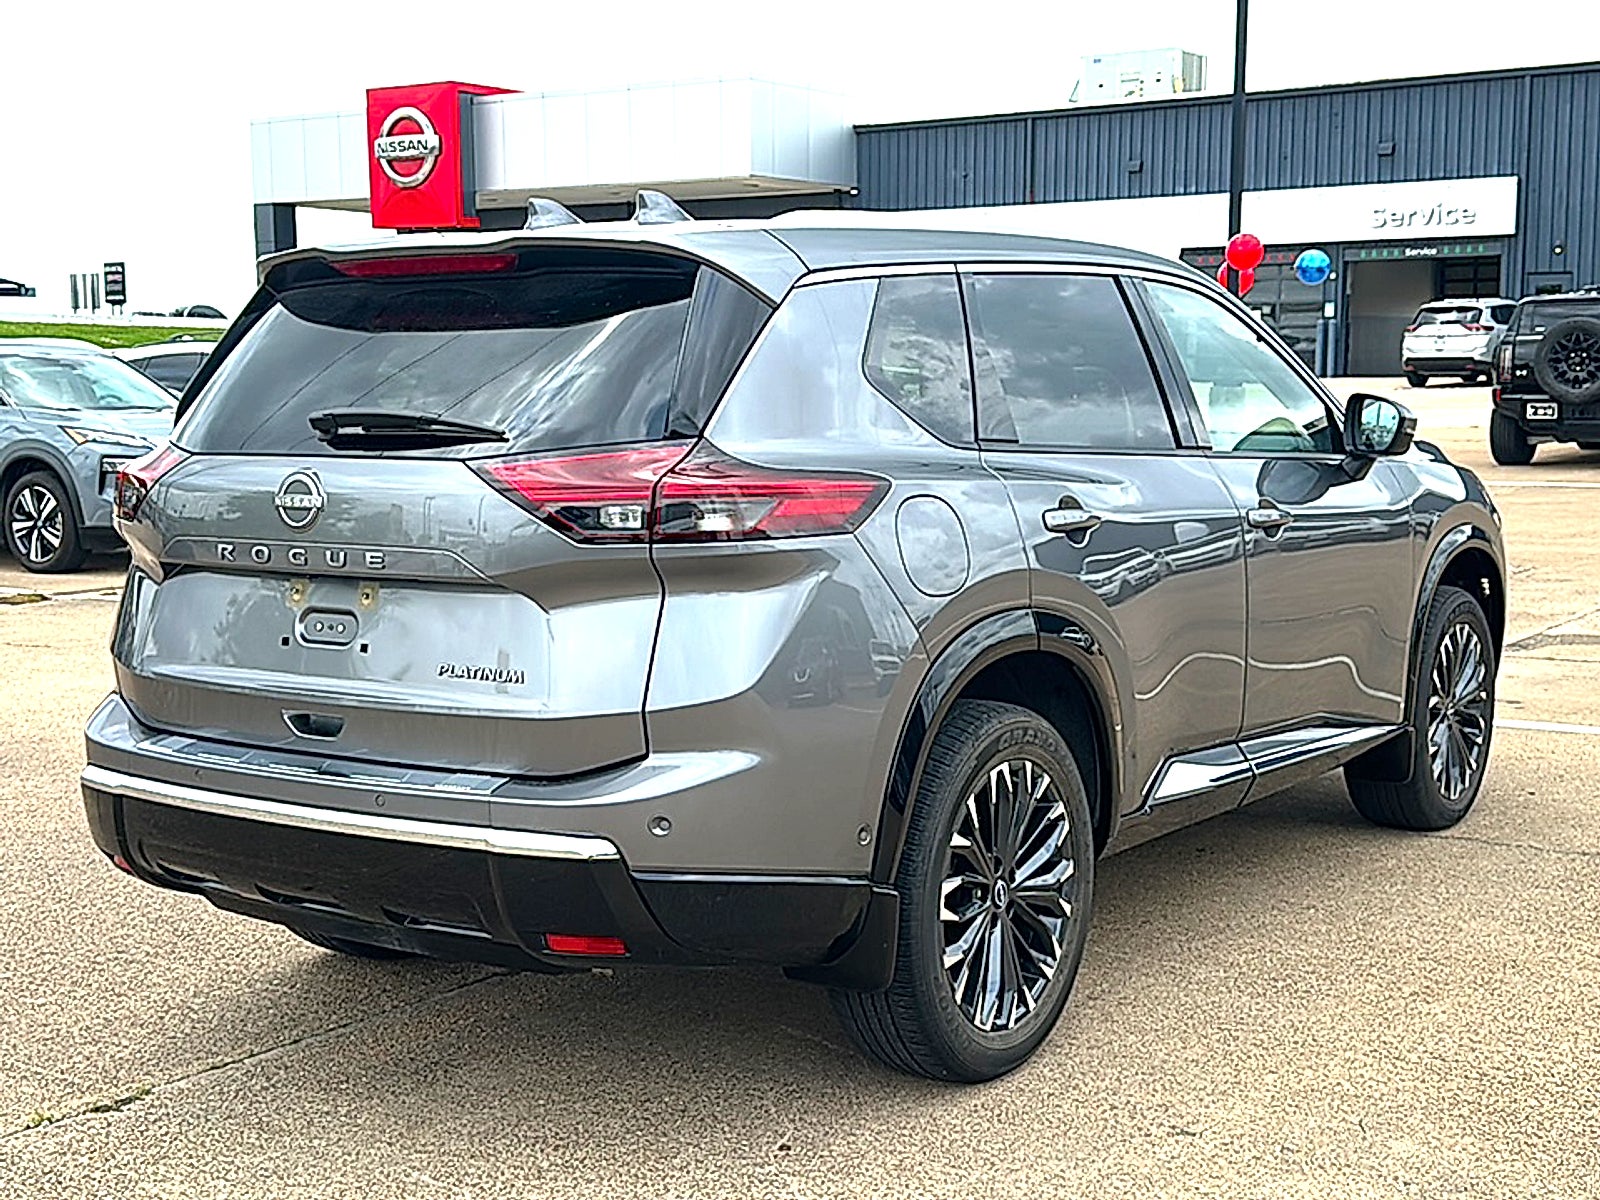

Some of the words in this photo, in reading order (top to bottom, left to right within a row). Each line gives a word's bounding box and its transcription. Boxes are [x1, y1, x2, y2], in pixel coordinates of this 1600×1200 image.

[376, 138, 429, 154] NISSAN
[1370, 202, 1477, 230] Service
[1404, 246, 1438, 257] Service
[275, 494, 322, 508] NISSAN
[216, 542, 387, 571] ROGUE
[436, 662, 525, 685] PLATINUM
